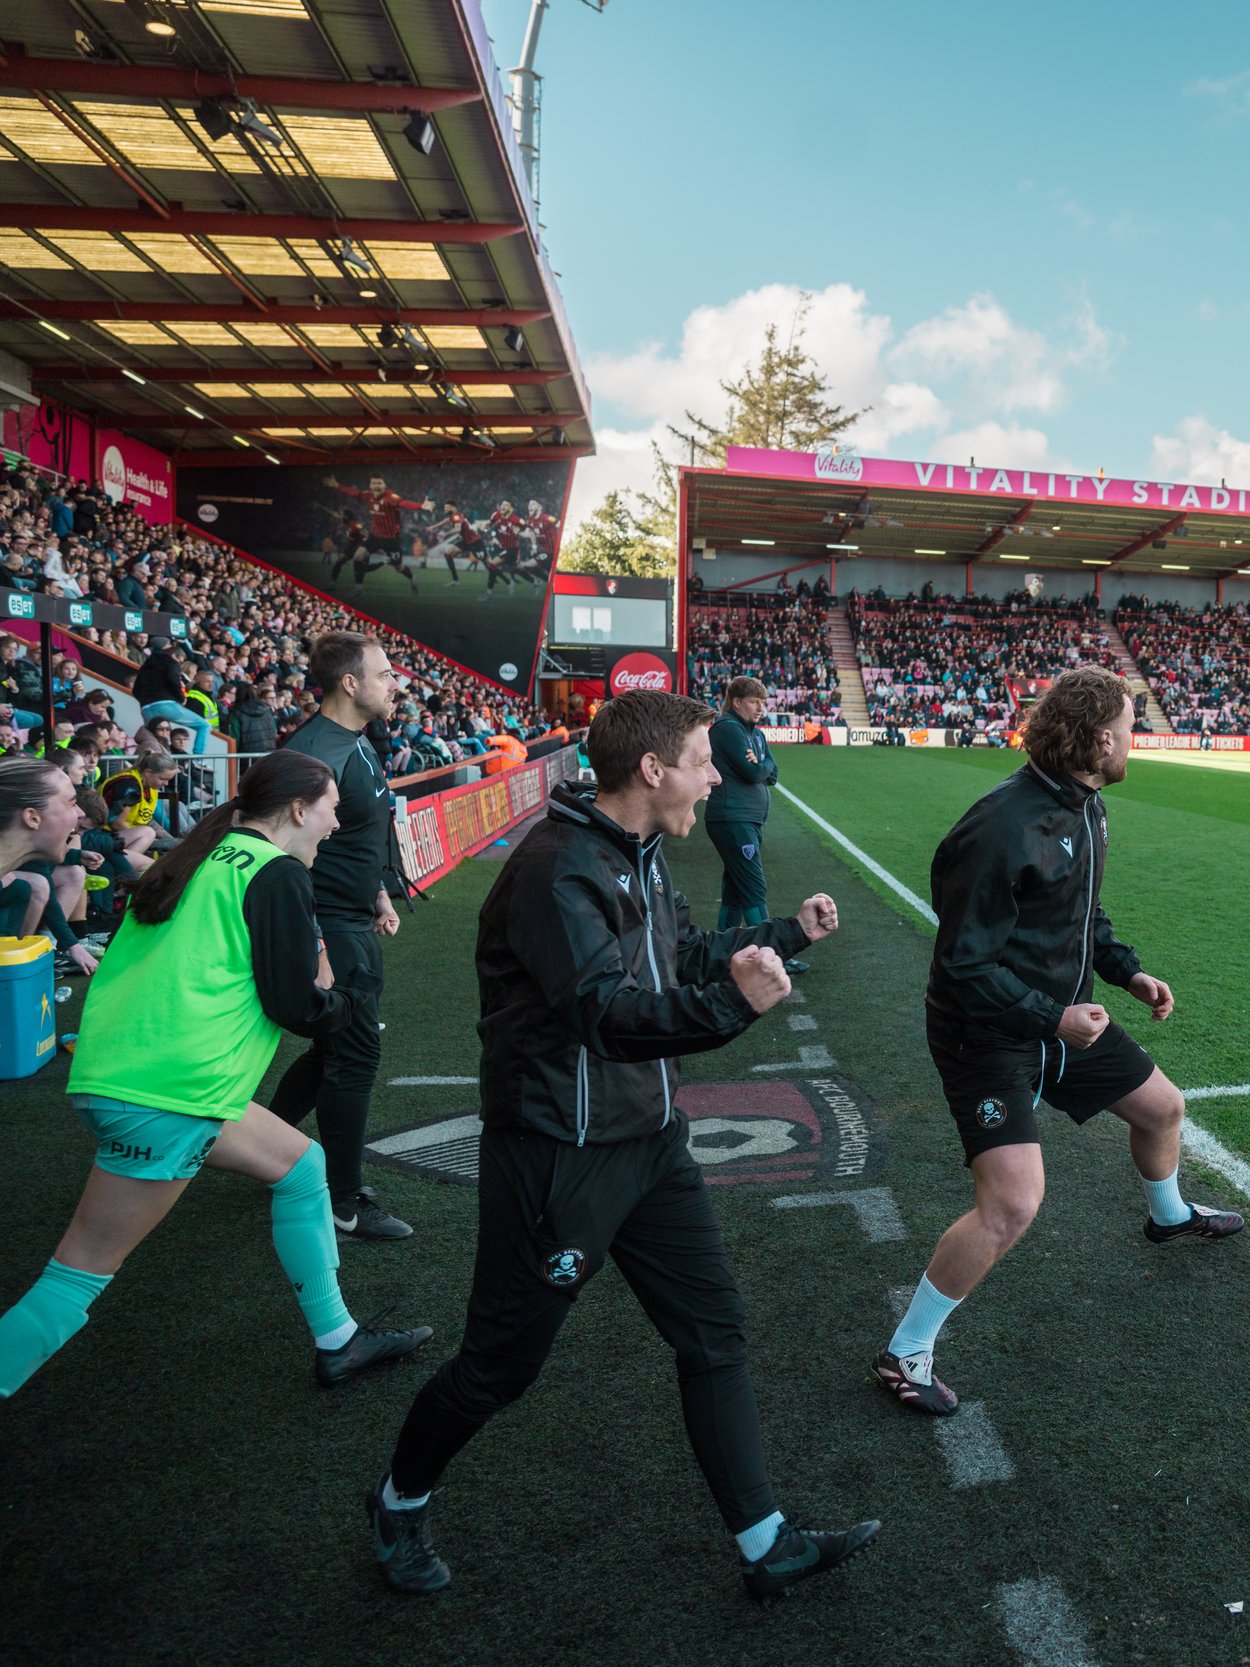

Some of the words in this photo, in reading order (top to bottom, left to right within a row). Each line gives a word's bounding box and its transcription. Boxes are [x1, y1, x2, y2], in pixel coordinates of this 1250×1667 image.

[817, 454, 861, 479] Vitality
[126, 467, 149, 491] Health
[155, 479, 168, 498] Life
[914, 462, 1111, 500] VITALITY
[615, 670, 667, 688] Coca-Cola
[766, 728, 798, 743] NSORED
[1134, 735, 1165, 748] PREMIER
[1166, 736, 1190, 749] LEAGUE
[1216, 737, 1244, 750] TICKETS
[823, 1095, 869, 1176] BOURNEMOUTH
[111, 1141, 152, 1160] PJH
